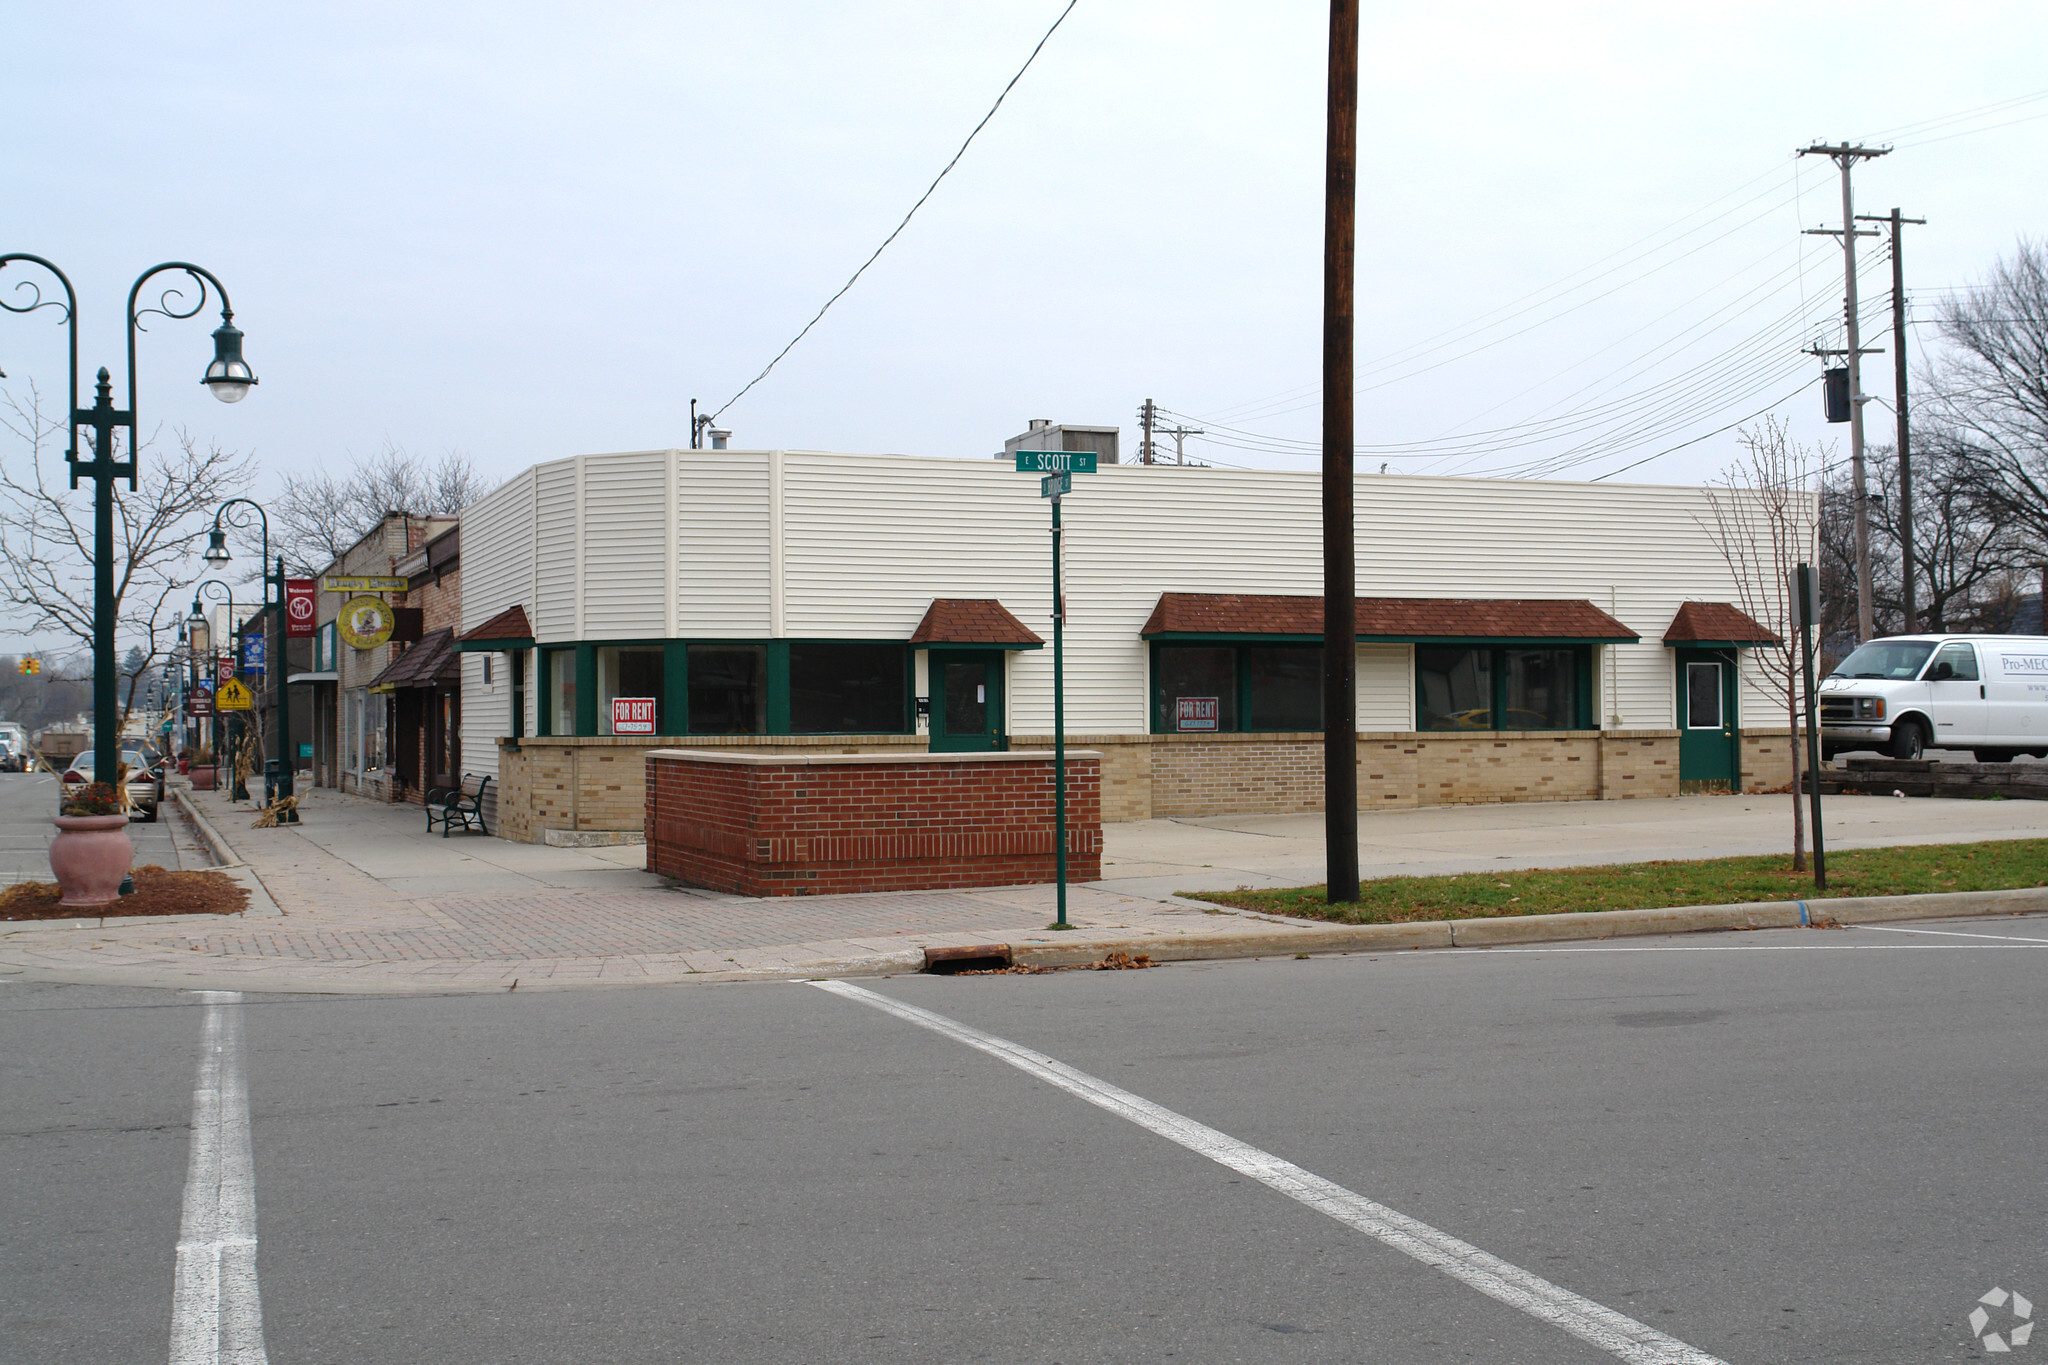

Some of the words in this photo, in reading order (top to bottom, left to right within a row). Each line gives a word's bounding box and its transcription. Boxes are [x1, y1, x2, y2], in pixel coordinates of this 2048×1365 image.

[1025, 456, 1029, 464] E
[1037, 453, 1072, 470] SCOTT
[1079, 457, 1086, 466] ST
[615, 702, 630, 720] FOR
[632, 702, 652, 720] RENT
[1179, 701, 1194, 718] FOR
[1195, 701, 1215, 718] RENT
